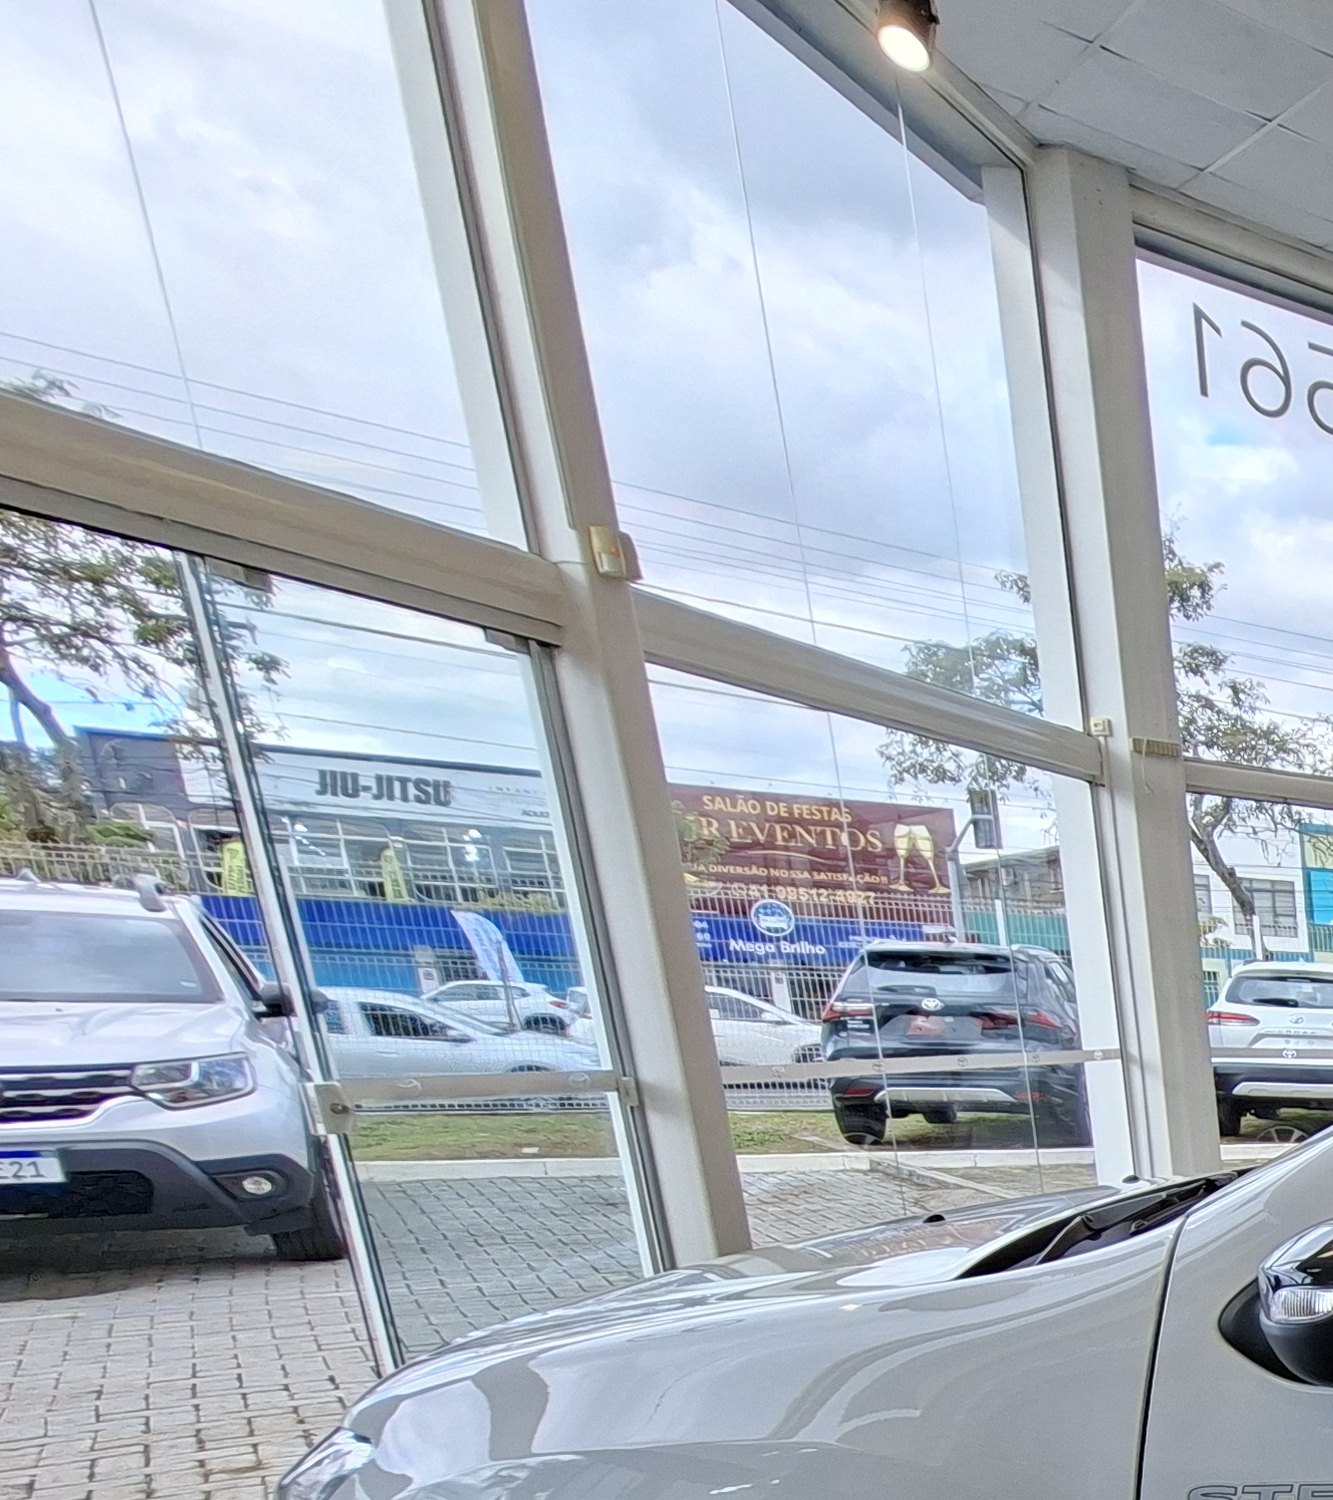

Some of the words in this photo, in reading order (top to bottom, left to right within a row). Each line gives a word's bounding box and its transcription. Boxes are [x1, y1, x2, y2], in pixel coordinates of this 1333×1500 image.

[315, 768, 453, 807] JIU-JITSU
[704, 795, 761, 815] SALÃO
[766, 803, 789, 817] DE
[793, 805, 852, 823] FESTAS
[684, 816, 722, 842] R
[728, 819, 884, 852] EVENTOS
[769, 868, 811, 880] NOSSA
[729, 939, 776, 956] Mega
[780, 940, 827, 956] Brilho
